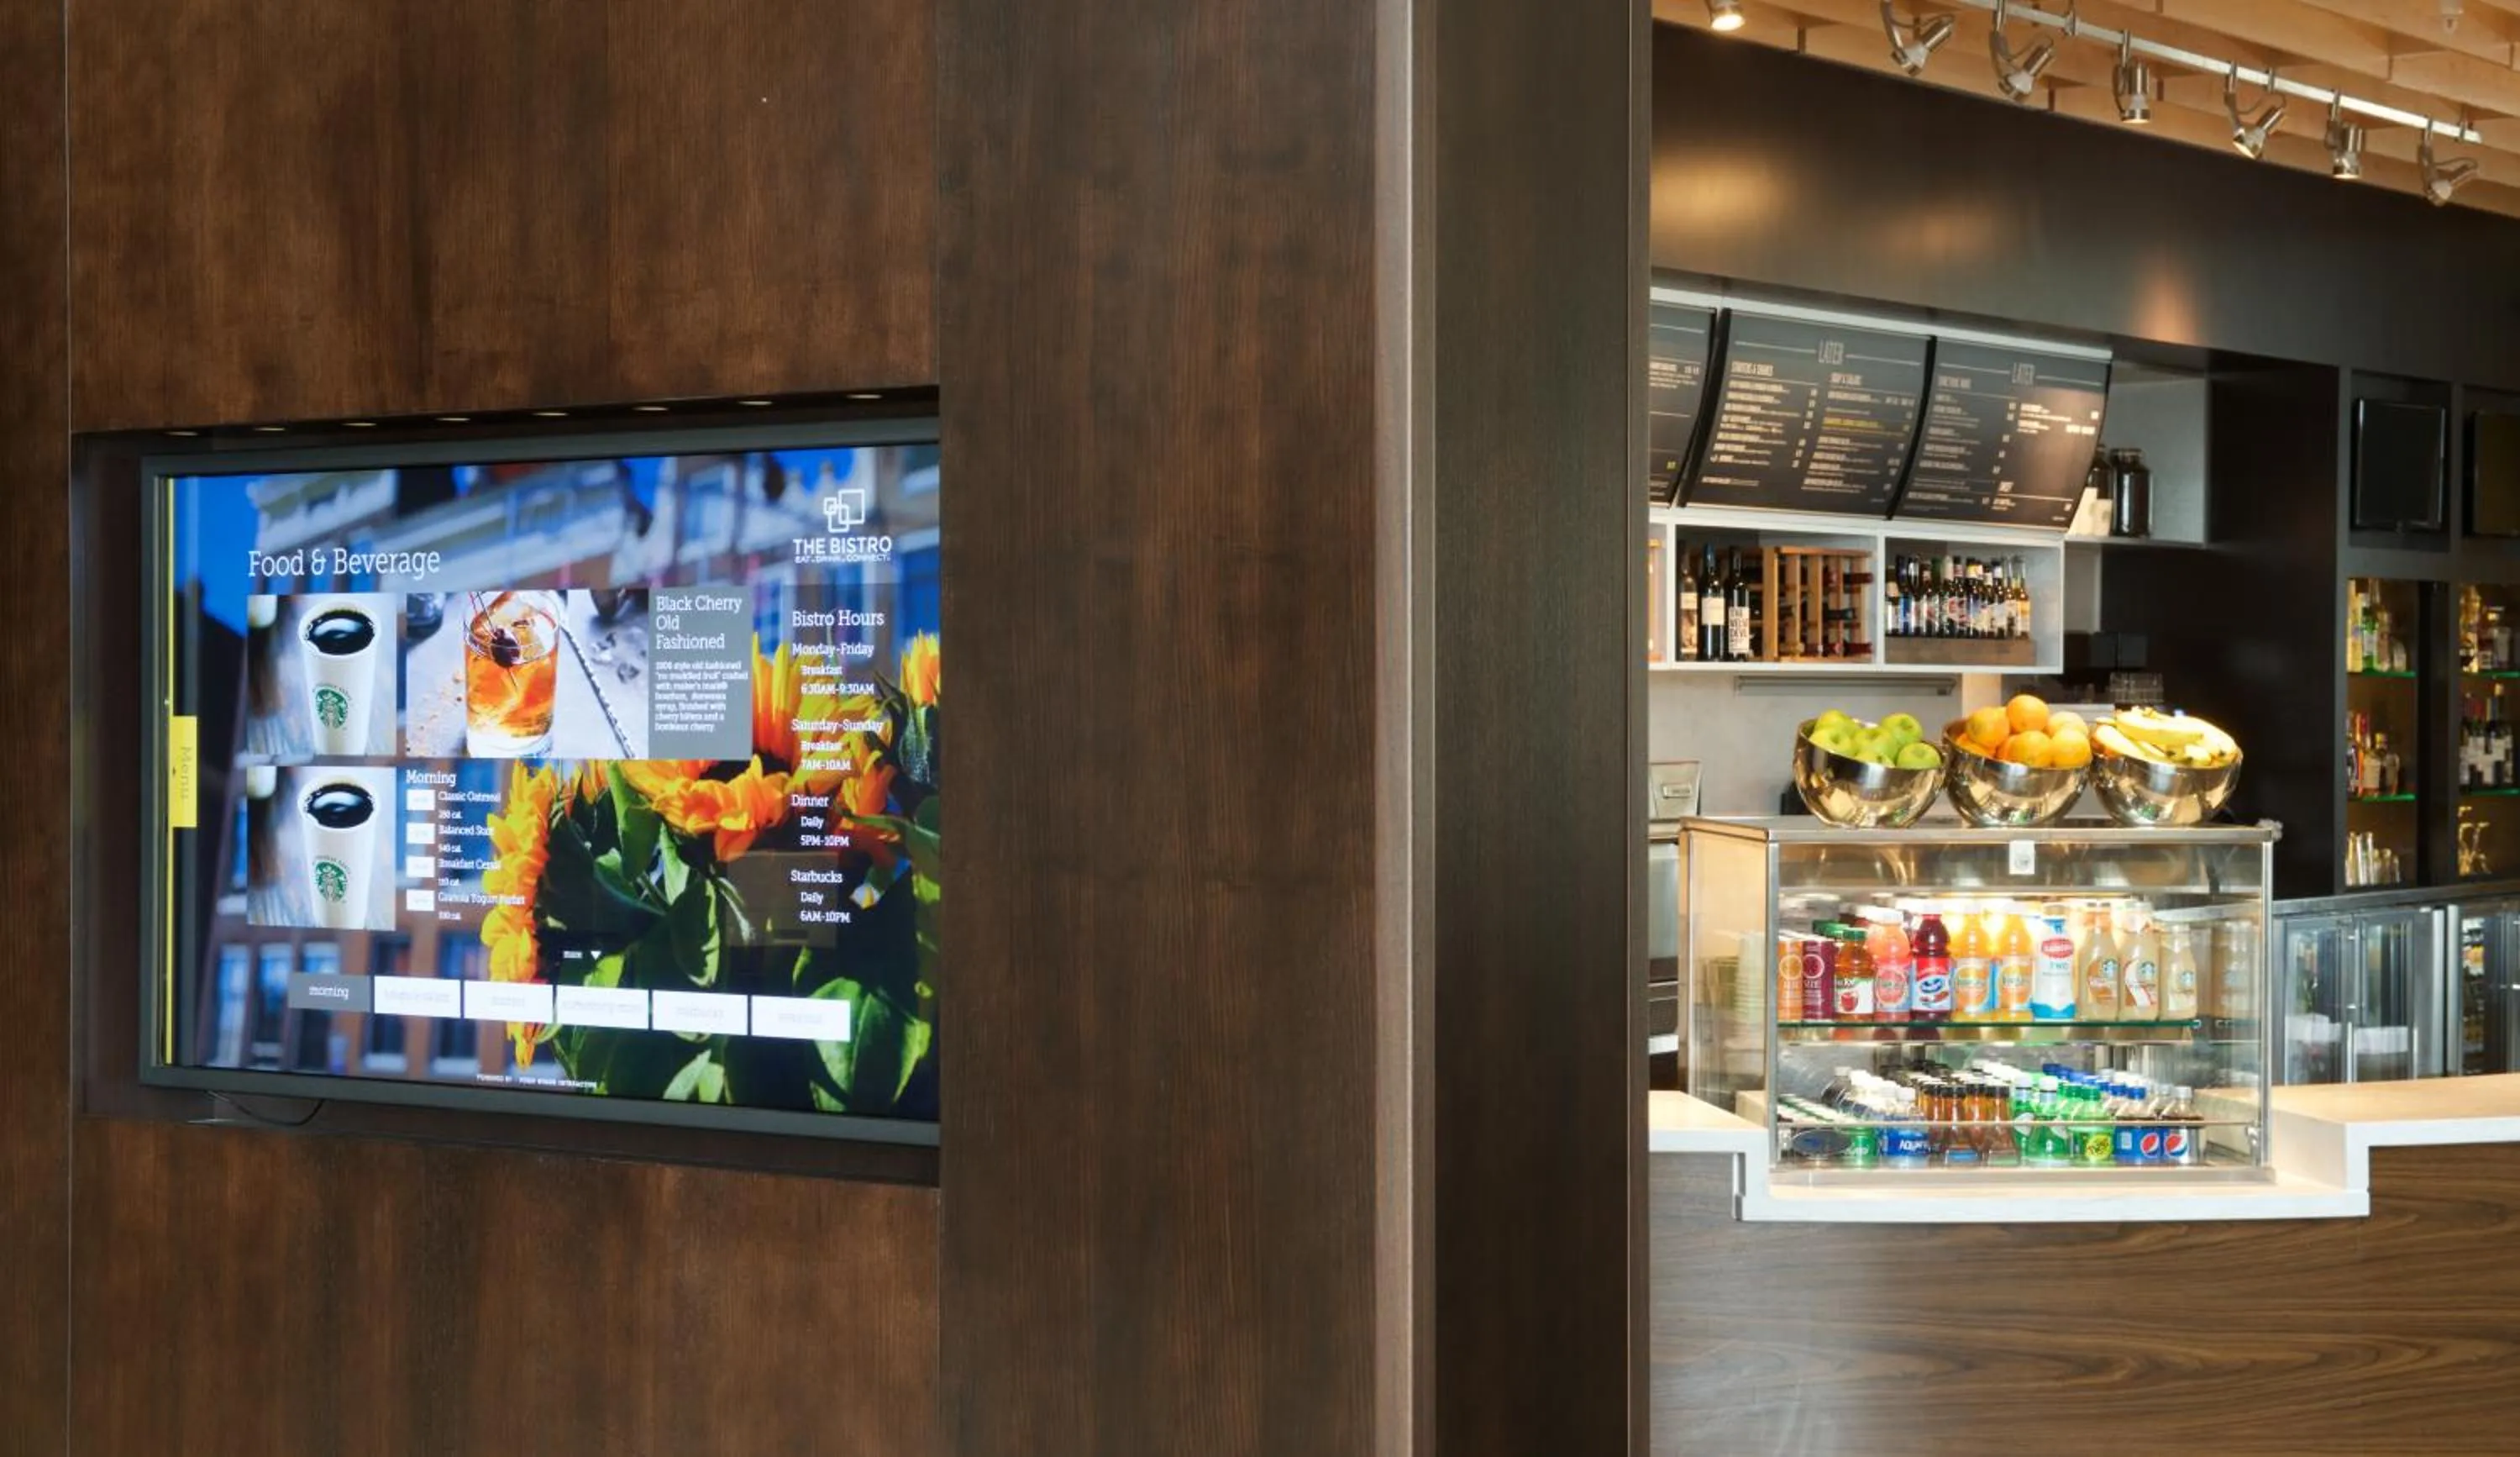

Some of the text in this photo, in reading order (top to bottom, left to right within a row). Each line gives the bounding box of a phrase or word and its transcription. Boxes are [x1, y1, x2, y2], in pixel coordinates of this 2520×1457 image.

[793, 536, 892, 555] THE BISTRO
[249, 548, 441, 581] Food & Beverage
[656, 595, 742, 614] Black Cherry
[656, 614, 680, 630] Old
[792, 609, 885, 627] Bistro Hours
[656, 633, 725, 650] Fashioned
[792, 642, 874, 658] Monday-Friday
[790, 718, 884, 734] Saturday-Sunday
[406, 769, 457, 786] Morning
[791, 794, 830, 807] Dinner
[801, 816, 824, 829] Daily
[790, 869, 843, 883] Starbucks
[801, 892, 824, 905] Daily
[800, 910, 852, 923] 6AM-10PM
[309, 984, 349, 1000] morning
